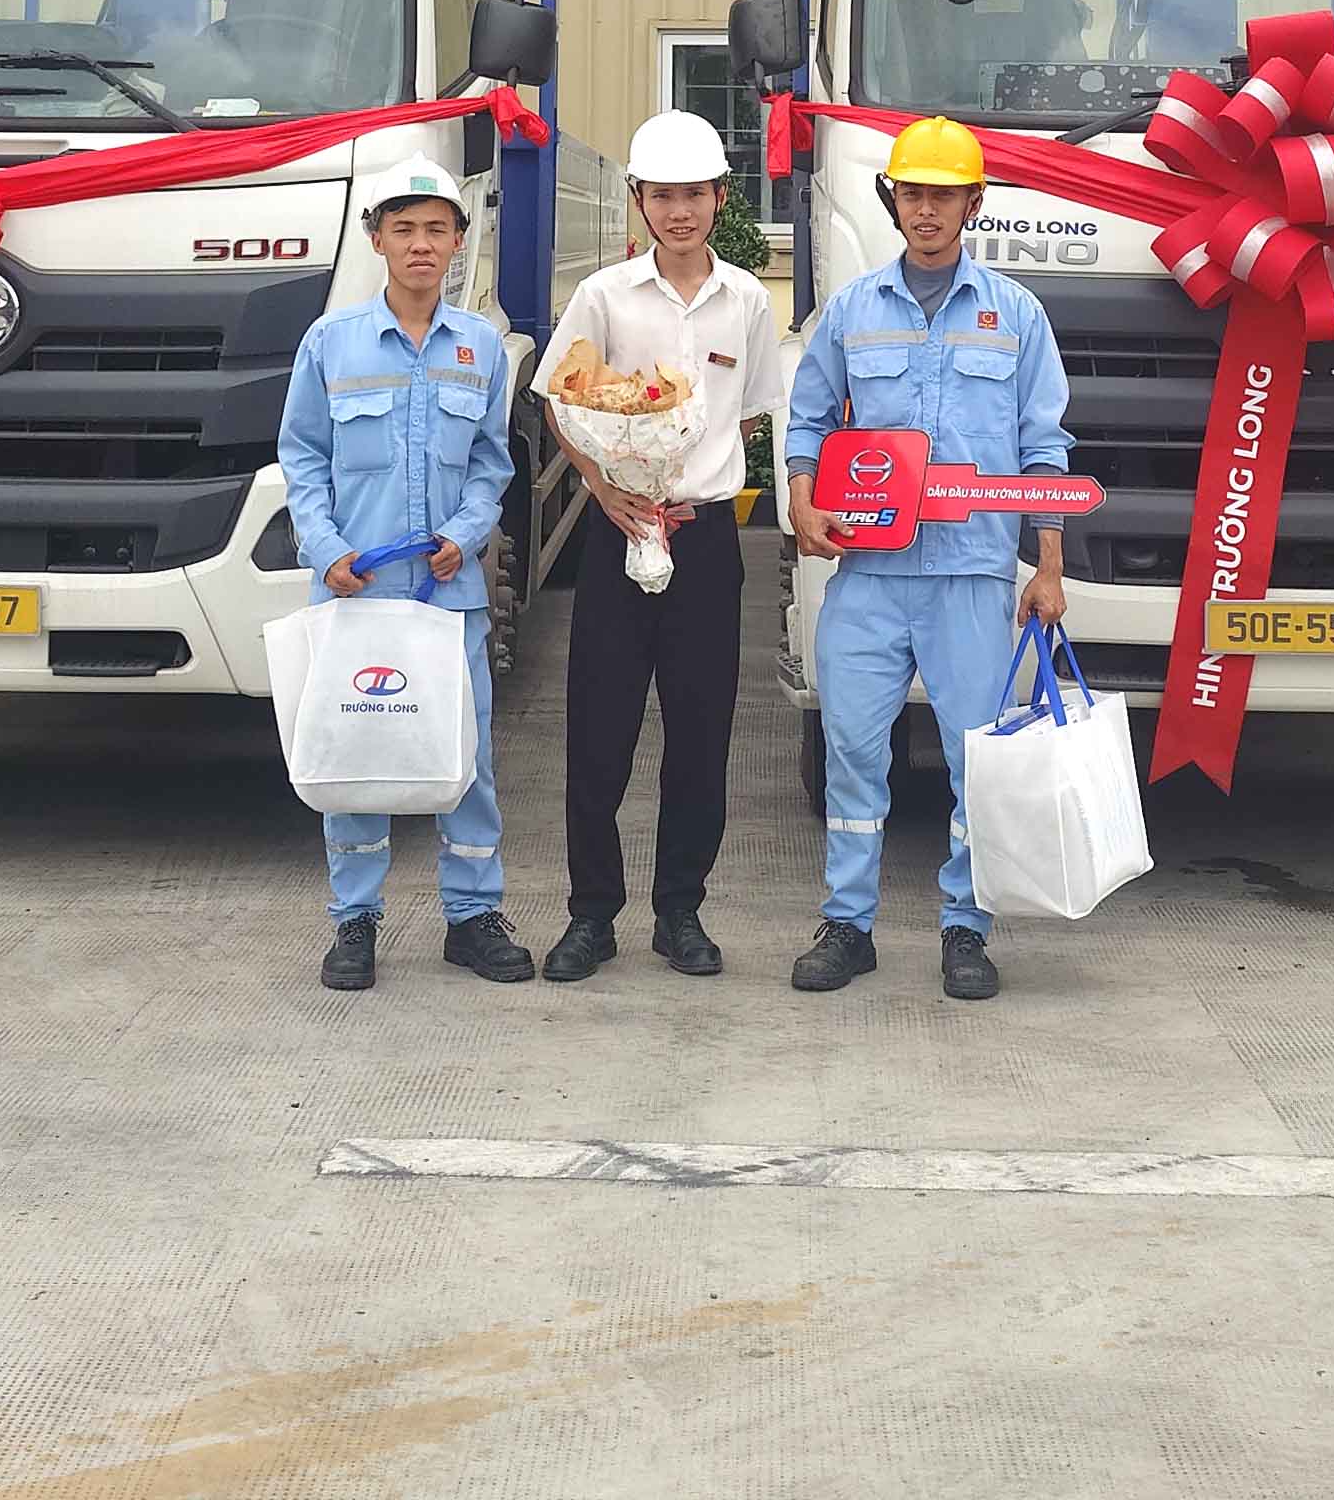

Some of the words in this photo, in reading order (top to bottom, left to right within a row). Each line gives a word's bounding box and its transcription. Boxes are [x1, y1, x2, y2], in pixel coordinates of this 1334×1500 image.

[964, 215, 1031, 233] ƯỜNG
[1036, 220, 1098, 236] LONG
[193, 238, 310, 262] 500
[969, 488, 985, 498] XU
[1023, 488, 1044, 503] VẬN
[1062, 490, 1091, 501] XANH
[1192, 651, 1225, 708] HIN
[1233, 363, 1273, 460] LONG
[388, 703, 419, 713] LONG
